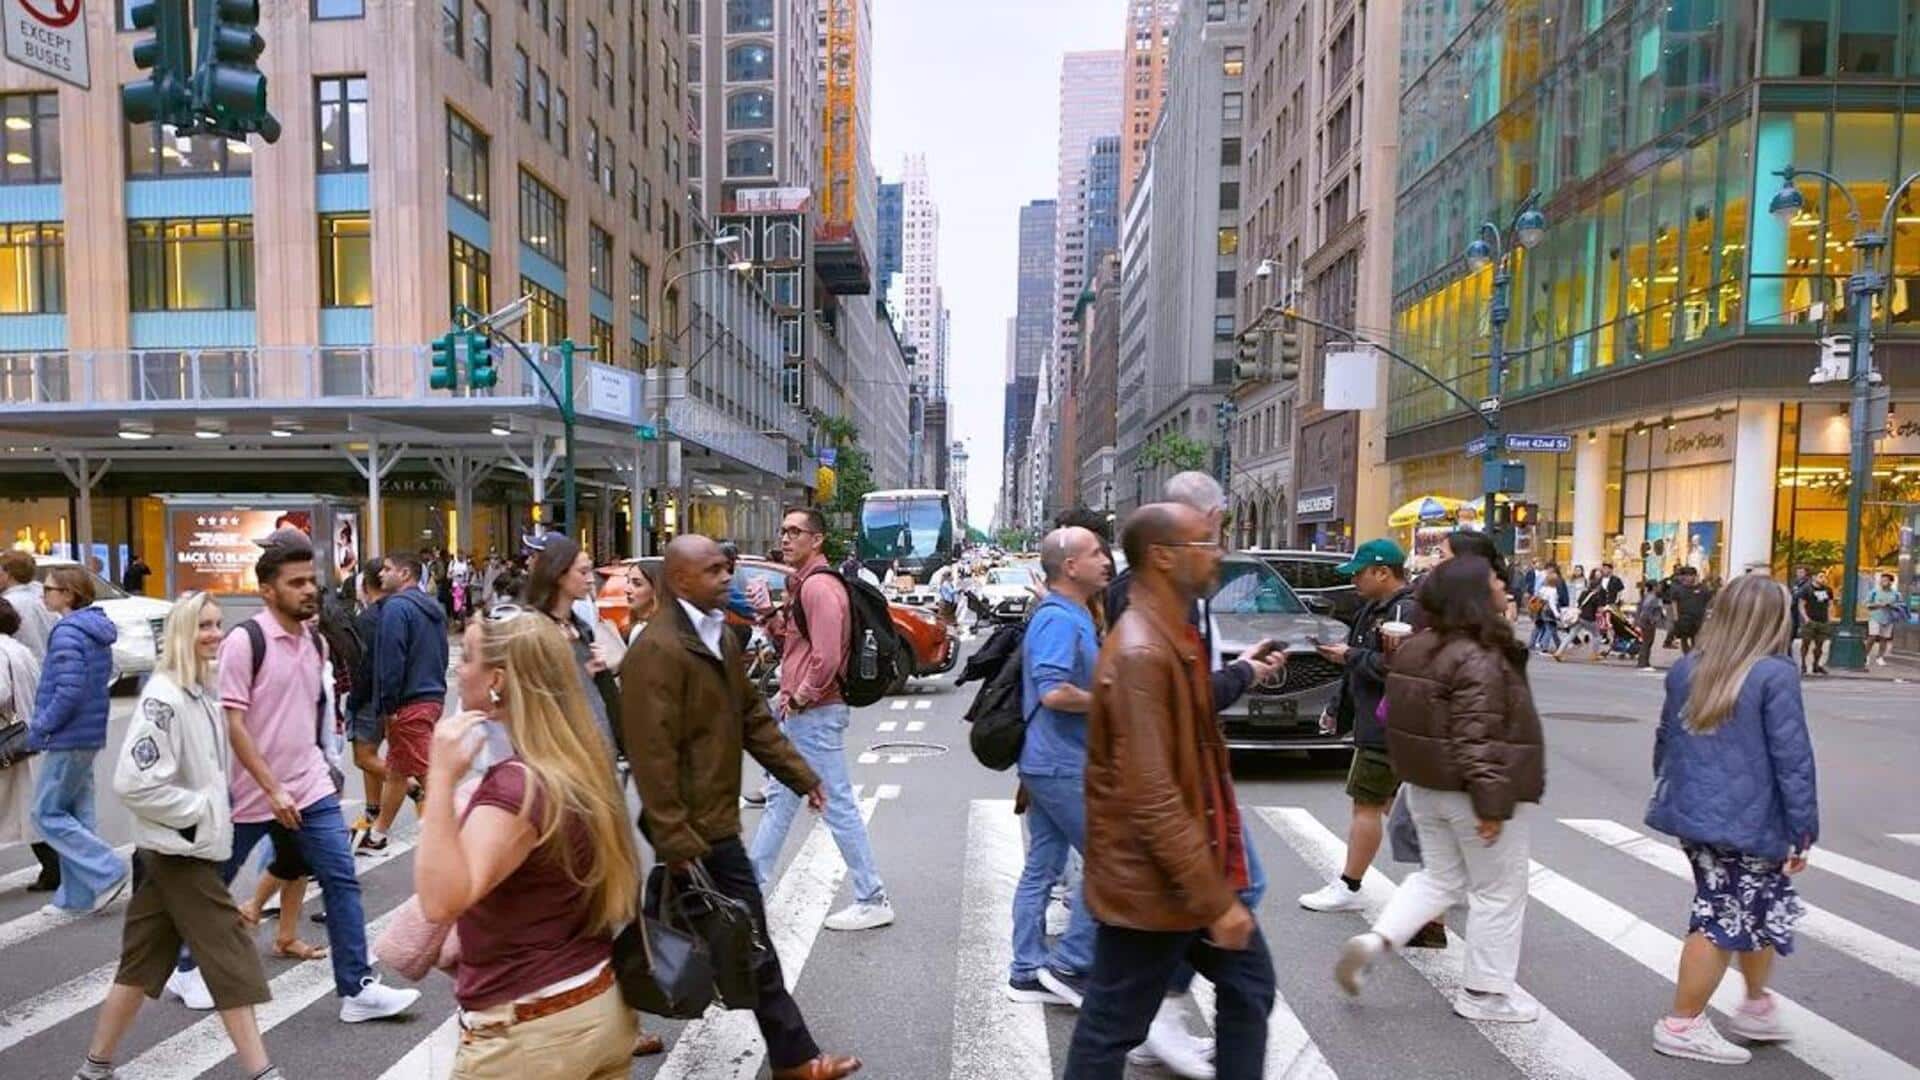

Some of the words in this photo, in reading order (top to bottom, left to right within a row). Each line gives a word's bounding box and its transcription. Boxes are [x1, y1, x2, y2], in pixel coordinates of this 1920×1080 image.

[21, 20, 72, 53] EXCEPT
[25, 41, 72, 71] BUSES
[1510, 438, 1530, 447] East
[1532, 439, 1554, 448] 42nd
[1556, 439, 1567, 448] St
[178, 551, 207, 562] BACK
[209, 551, 225, 562] TO
